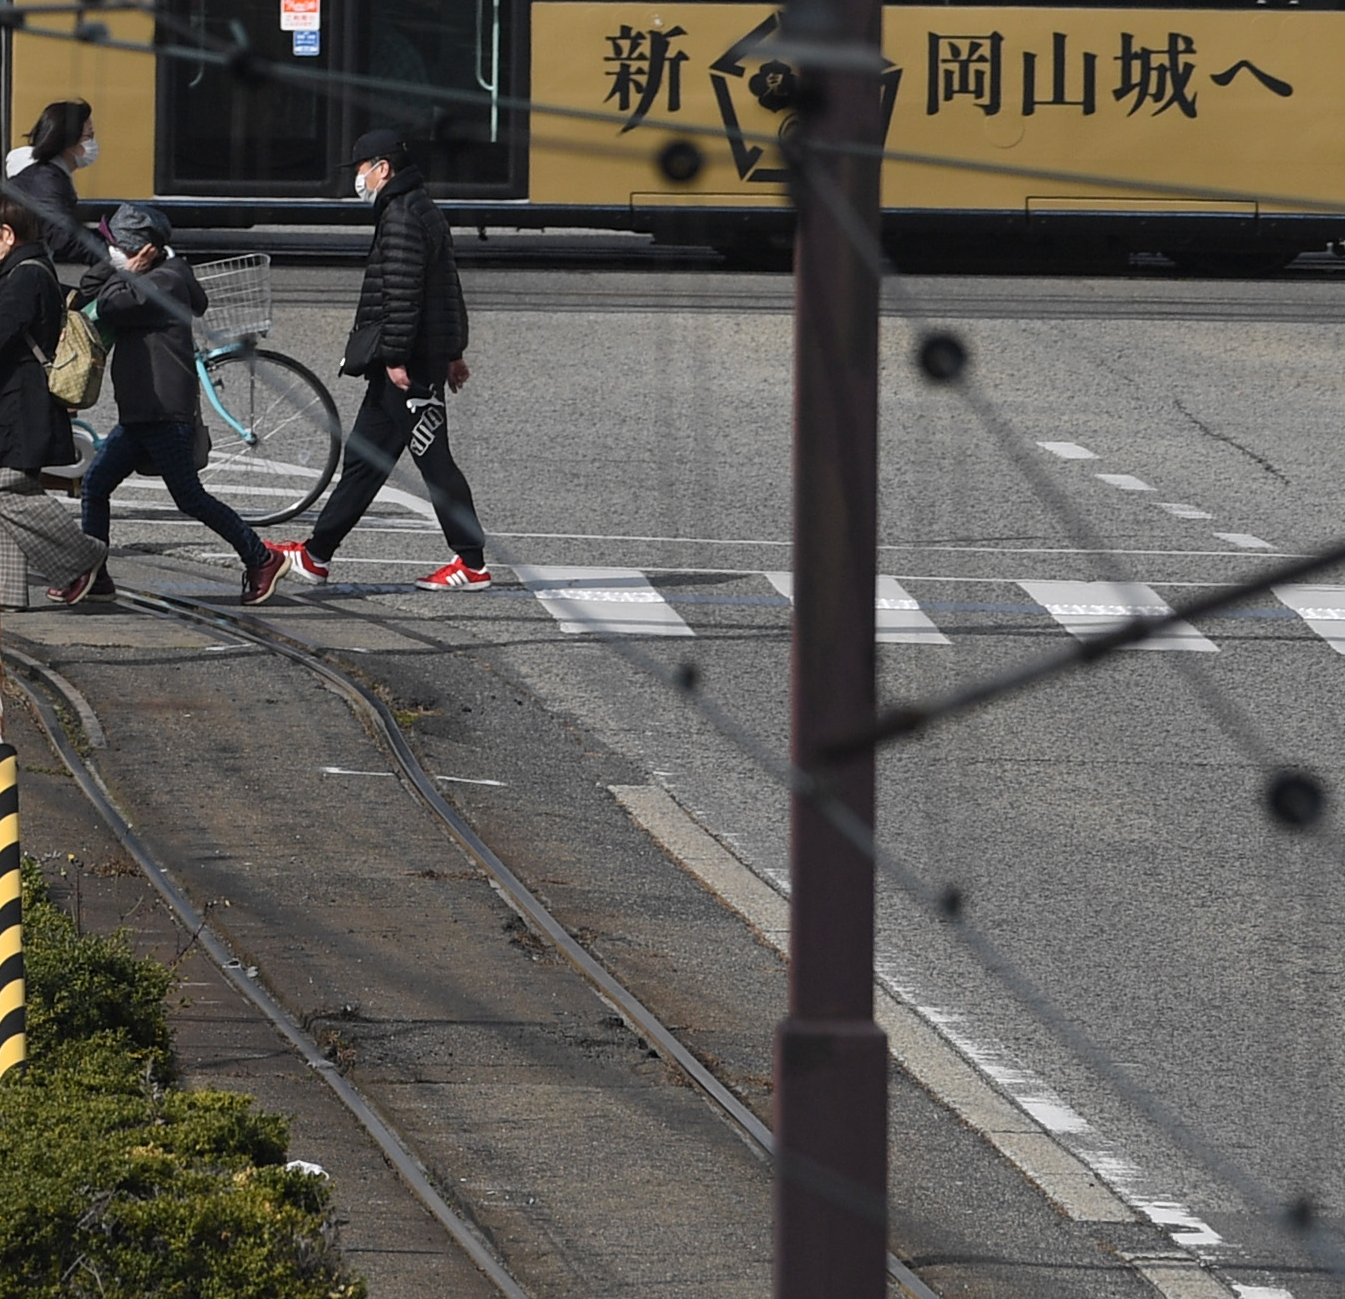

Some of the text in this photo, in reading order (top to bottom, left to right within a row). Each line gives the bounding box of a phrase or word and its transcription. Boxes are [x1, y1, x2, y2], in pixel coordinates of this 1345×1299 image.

[603, 24, 1294, 138] 新 岡山城へ
